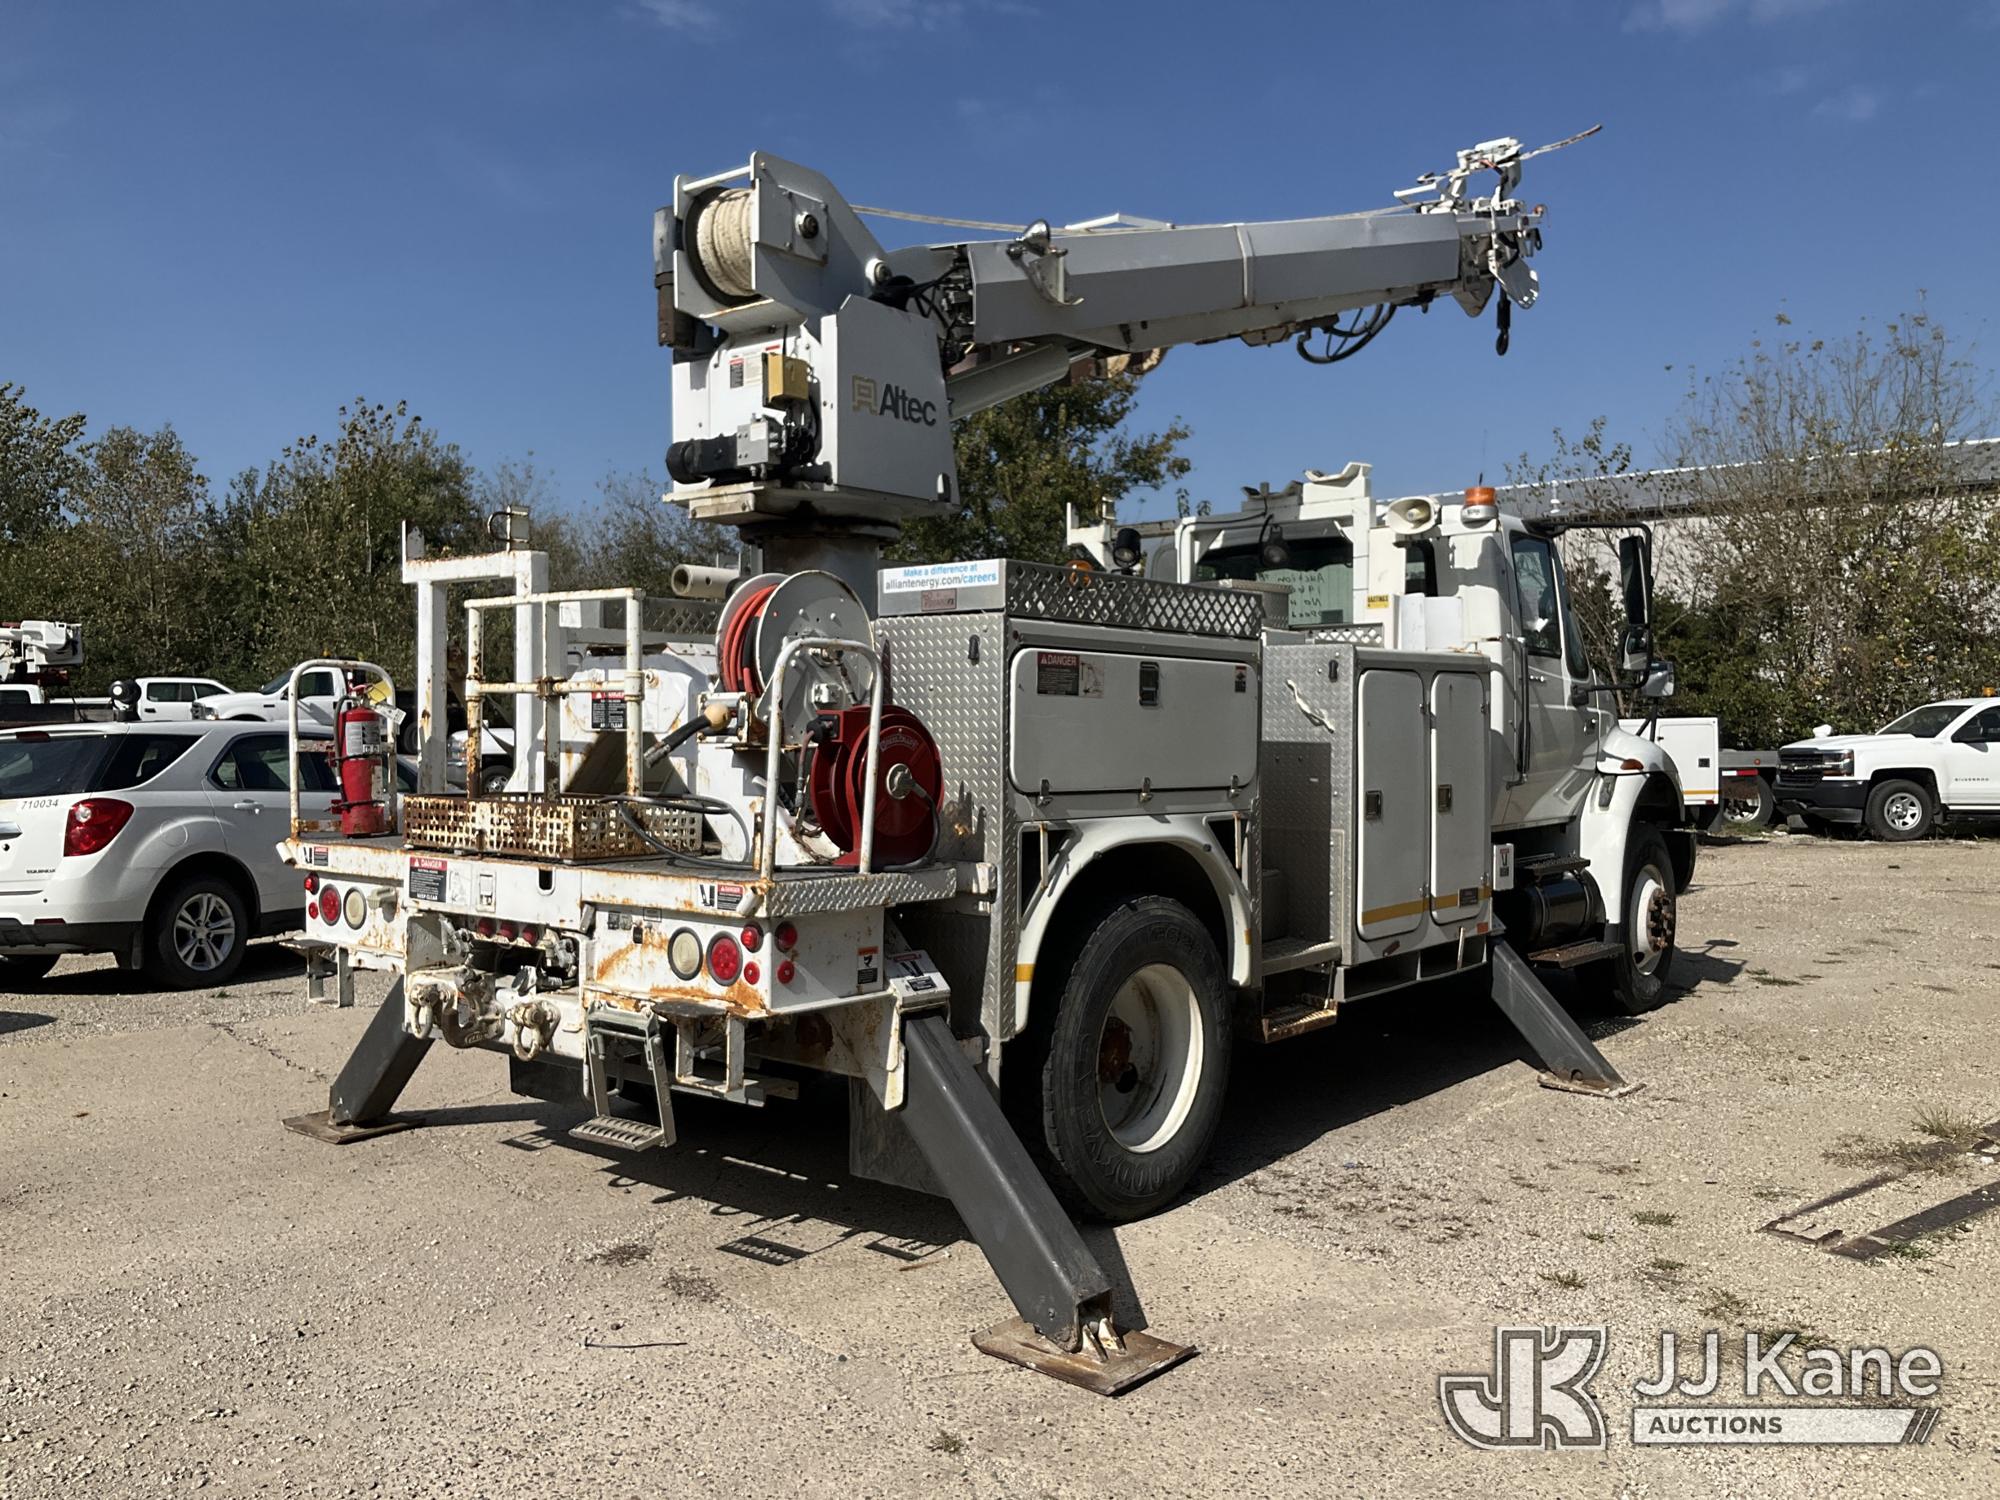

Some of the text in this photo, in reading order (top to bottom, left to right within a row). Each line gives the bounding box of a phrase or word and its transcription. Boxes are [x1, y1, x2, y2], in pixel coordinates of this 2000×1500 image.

[880, 383, 936, 427] Altec
[904, 569, 922, 577] Make
[931, 565, 968, 575] difference
[969, 563, 978, 572] at
[886, 572, 997, 589] alliantenergy.com/careers
[1047, 654, 1077, 666] DANGER
[21, 799, 59, 809] 710034
[421, 858, 443, 869] DANGER
